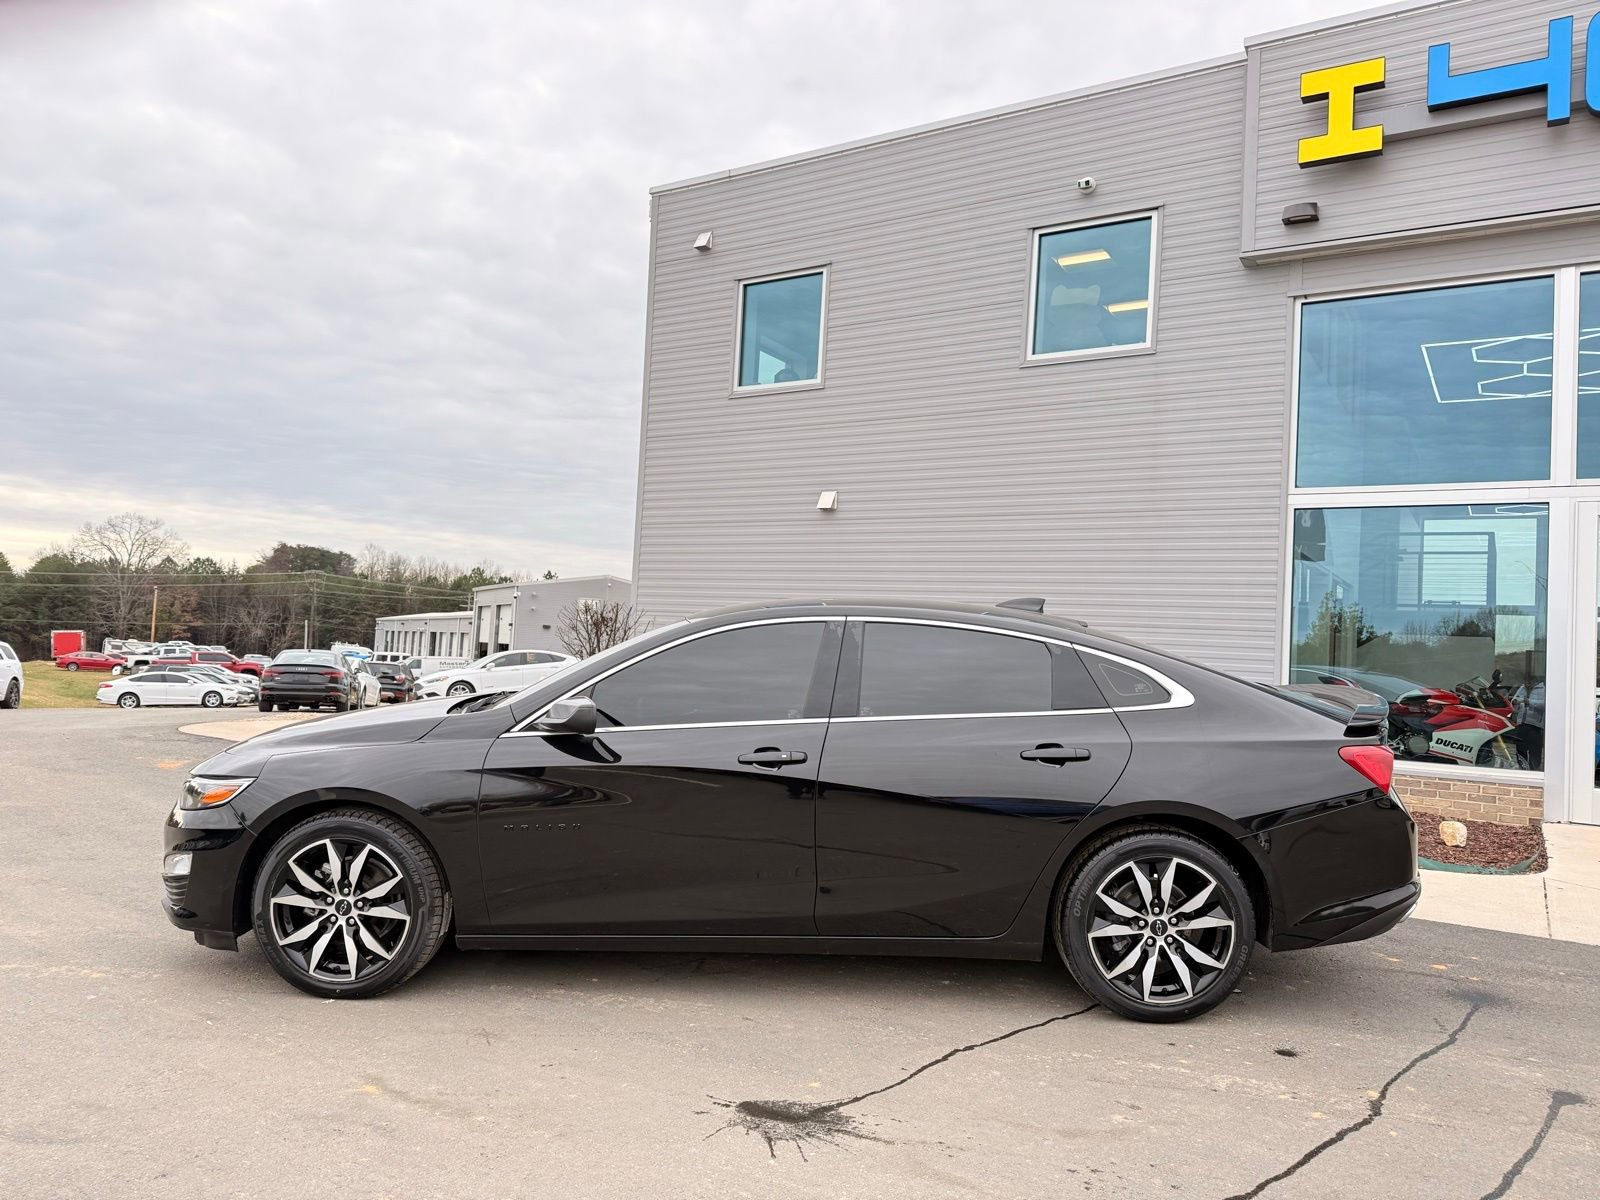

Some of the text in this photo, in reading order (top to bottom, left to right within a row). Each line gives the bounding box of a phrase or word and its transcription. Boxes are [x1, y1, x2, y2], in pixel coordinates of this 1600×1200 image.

[1297, 15, 1600, 169] I 4
[1435, 738, 1474, 753] DUCATI
